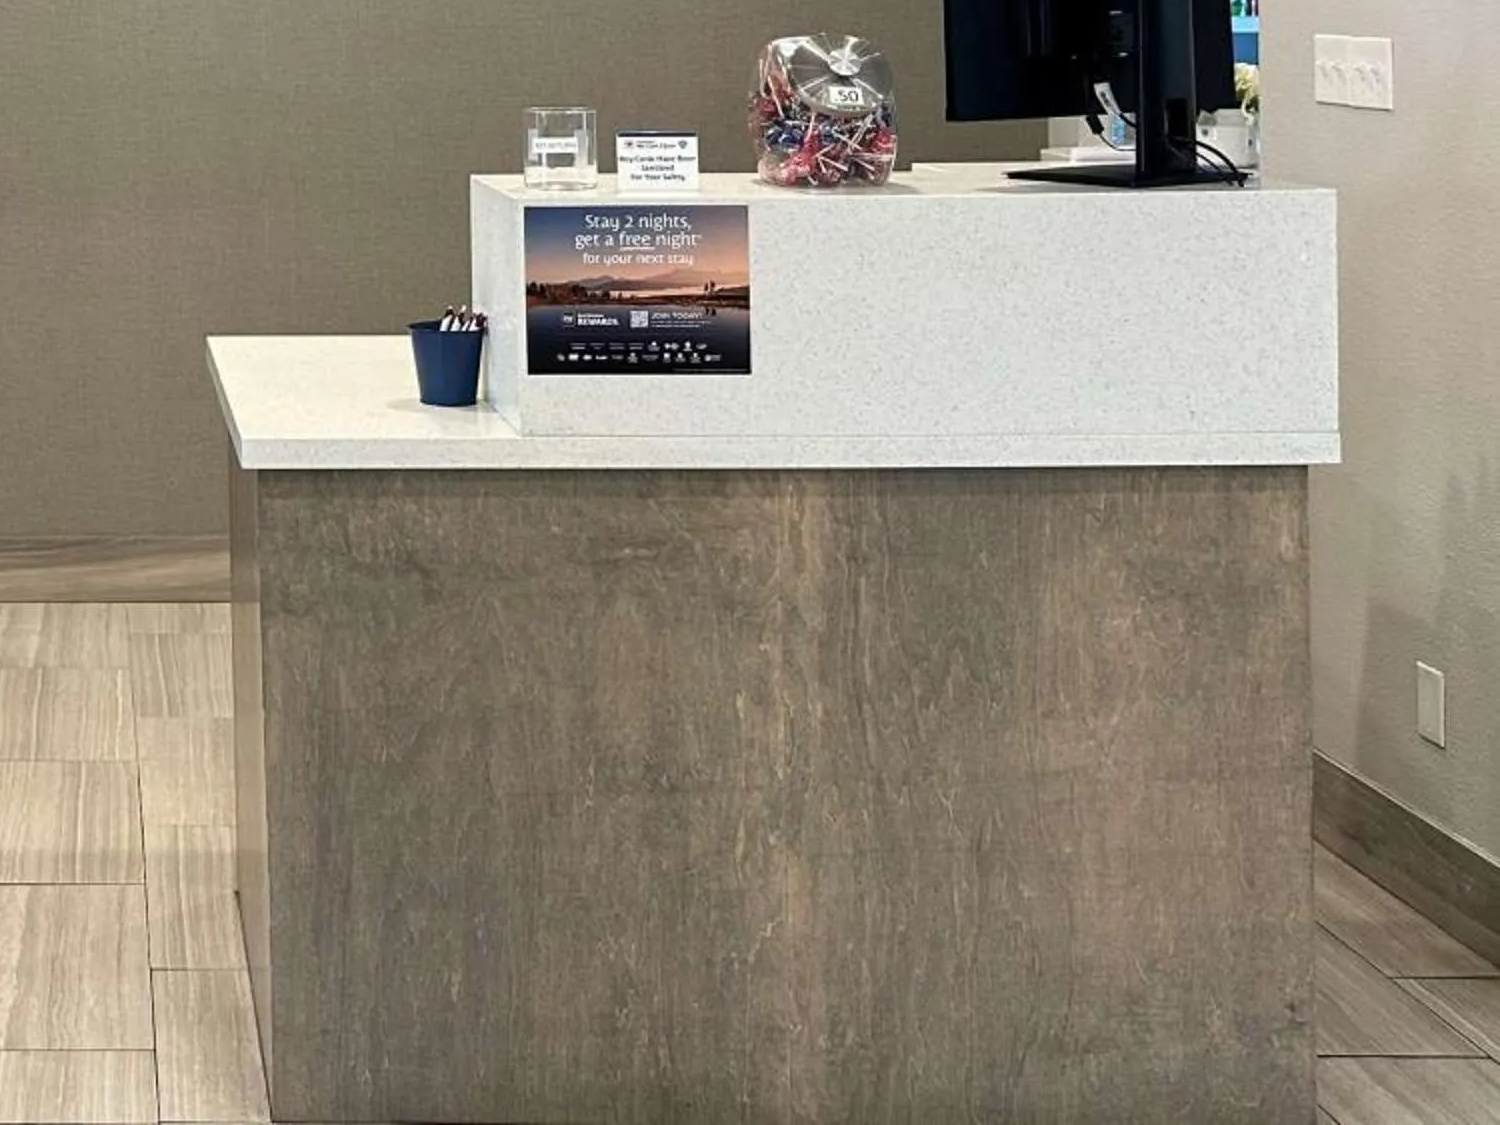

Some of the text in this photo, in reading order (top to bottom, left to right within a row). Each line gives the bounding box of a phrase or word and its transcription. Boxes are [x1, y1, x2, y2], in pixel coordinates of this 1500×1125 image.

[585, 213, 692, 231] Stay 2 nights,
[575, 234, 600, 250] get
[605, 235, 613, 246] a
[620, 231, 651, 246] free
[583, 252, 693, 266] for your next stay
